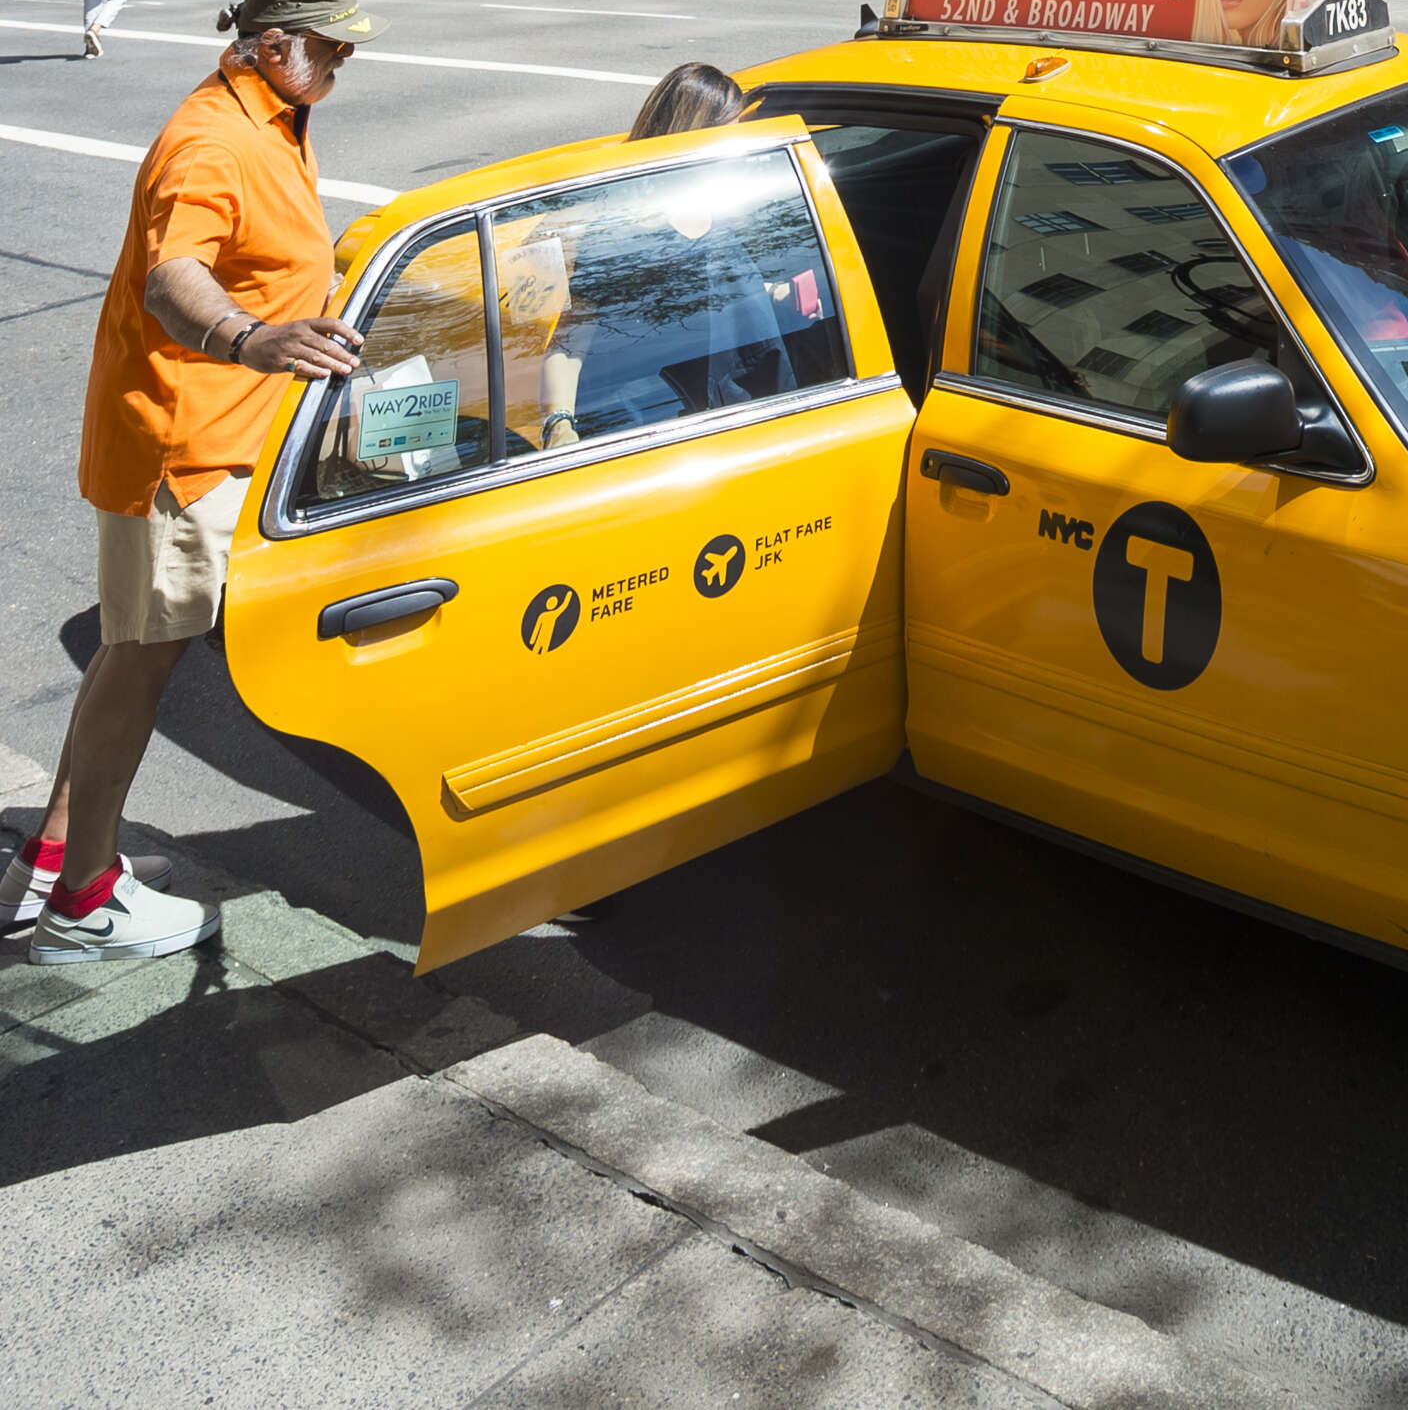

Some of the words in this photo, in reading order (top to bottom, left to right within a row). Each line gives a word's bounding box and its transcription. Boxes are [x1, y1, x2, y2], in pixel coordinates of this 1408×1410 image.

[368, 391, 453, 418] WAY2RIDE
[754, 528, 791, 552] FLAT
[795, 515, 833, 539] FARE
[754, 549, 784, 571] JFK
[591, 566, 670, 603] METERED
[1038, 508, 1095, 551] NYC
[1126, 534, 1195, 665] T
[590, 596, 634, 622] FARE
